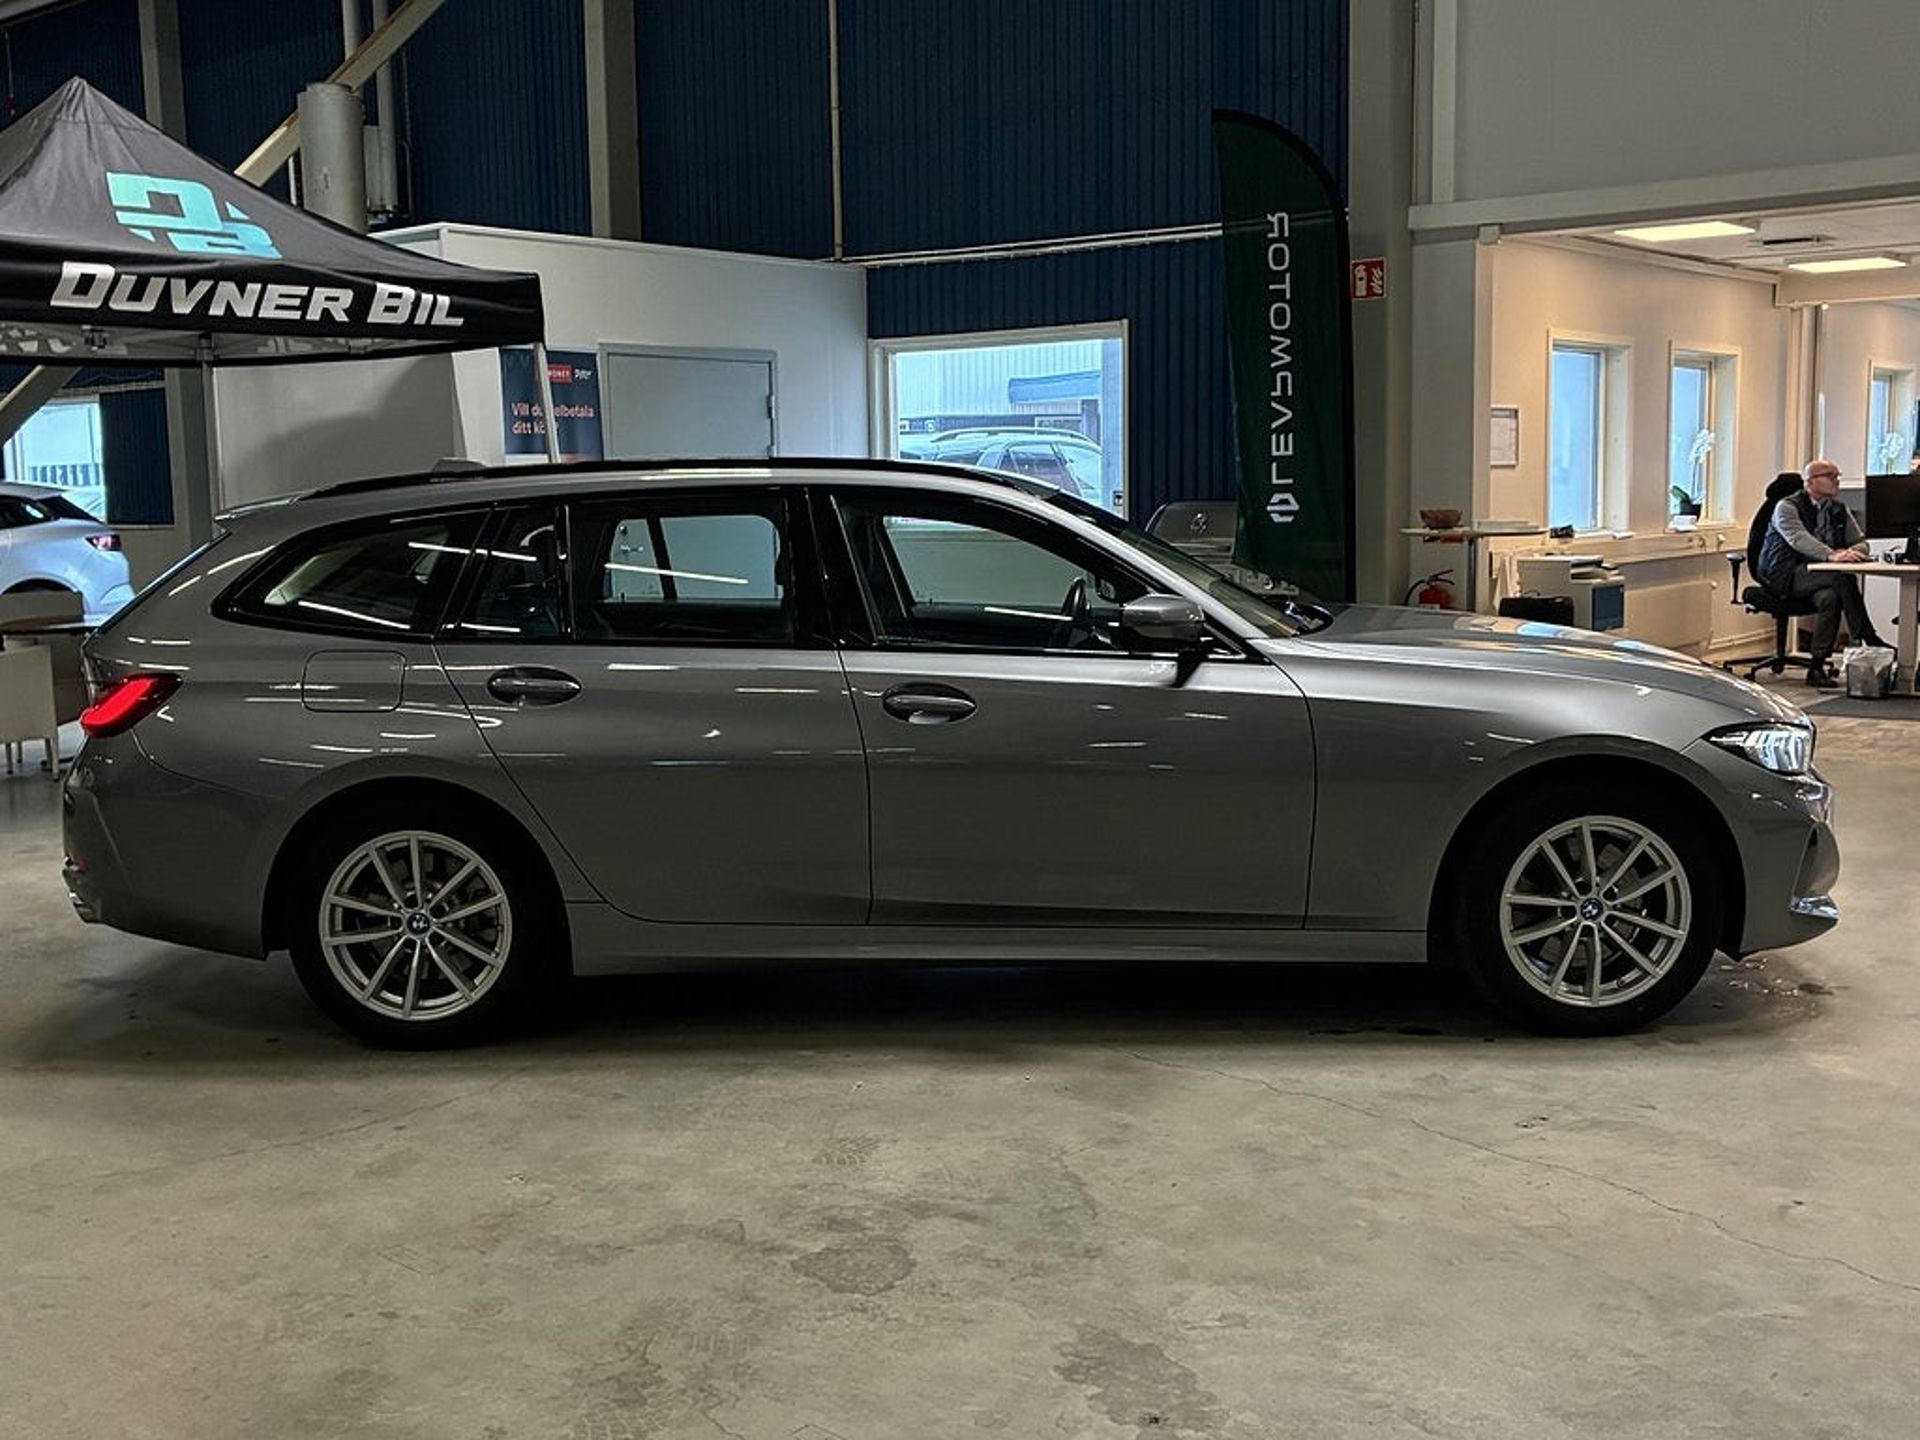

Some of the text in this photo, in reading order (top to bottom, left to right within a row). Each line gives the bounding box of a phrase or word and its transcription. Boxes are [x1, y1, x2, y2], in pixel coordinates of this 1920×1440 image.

[50, 261, 465, 327] DUVNER BIL
[554, 405, 594, 417] elbetala
